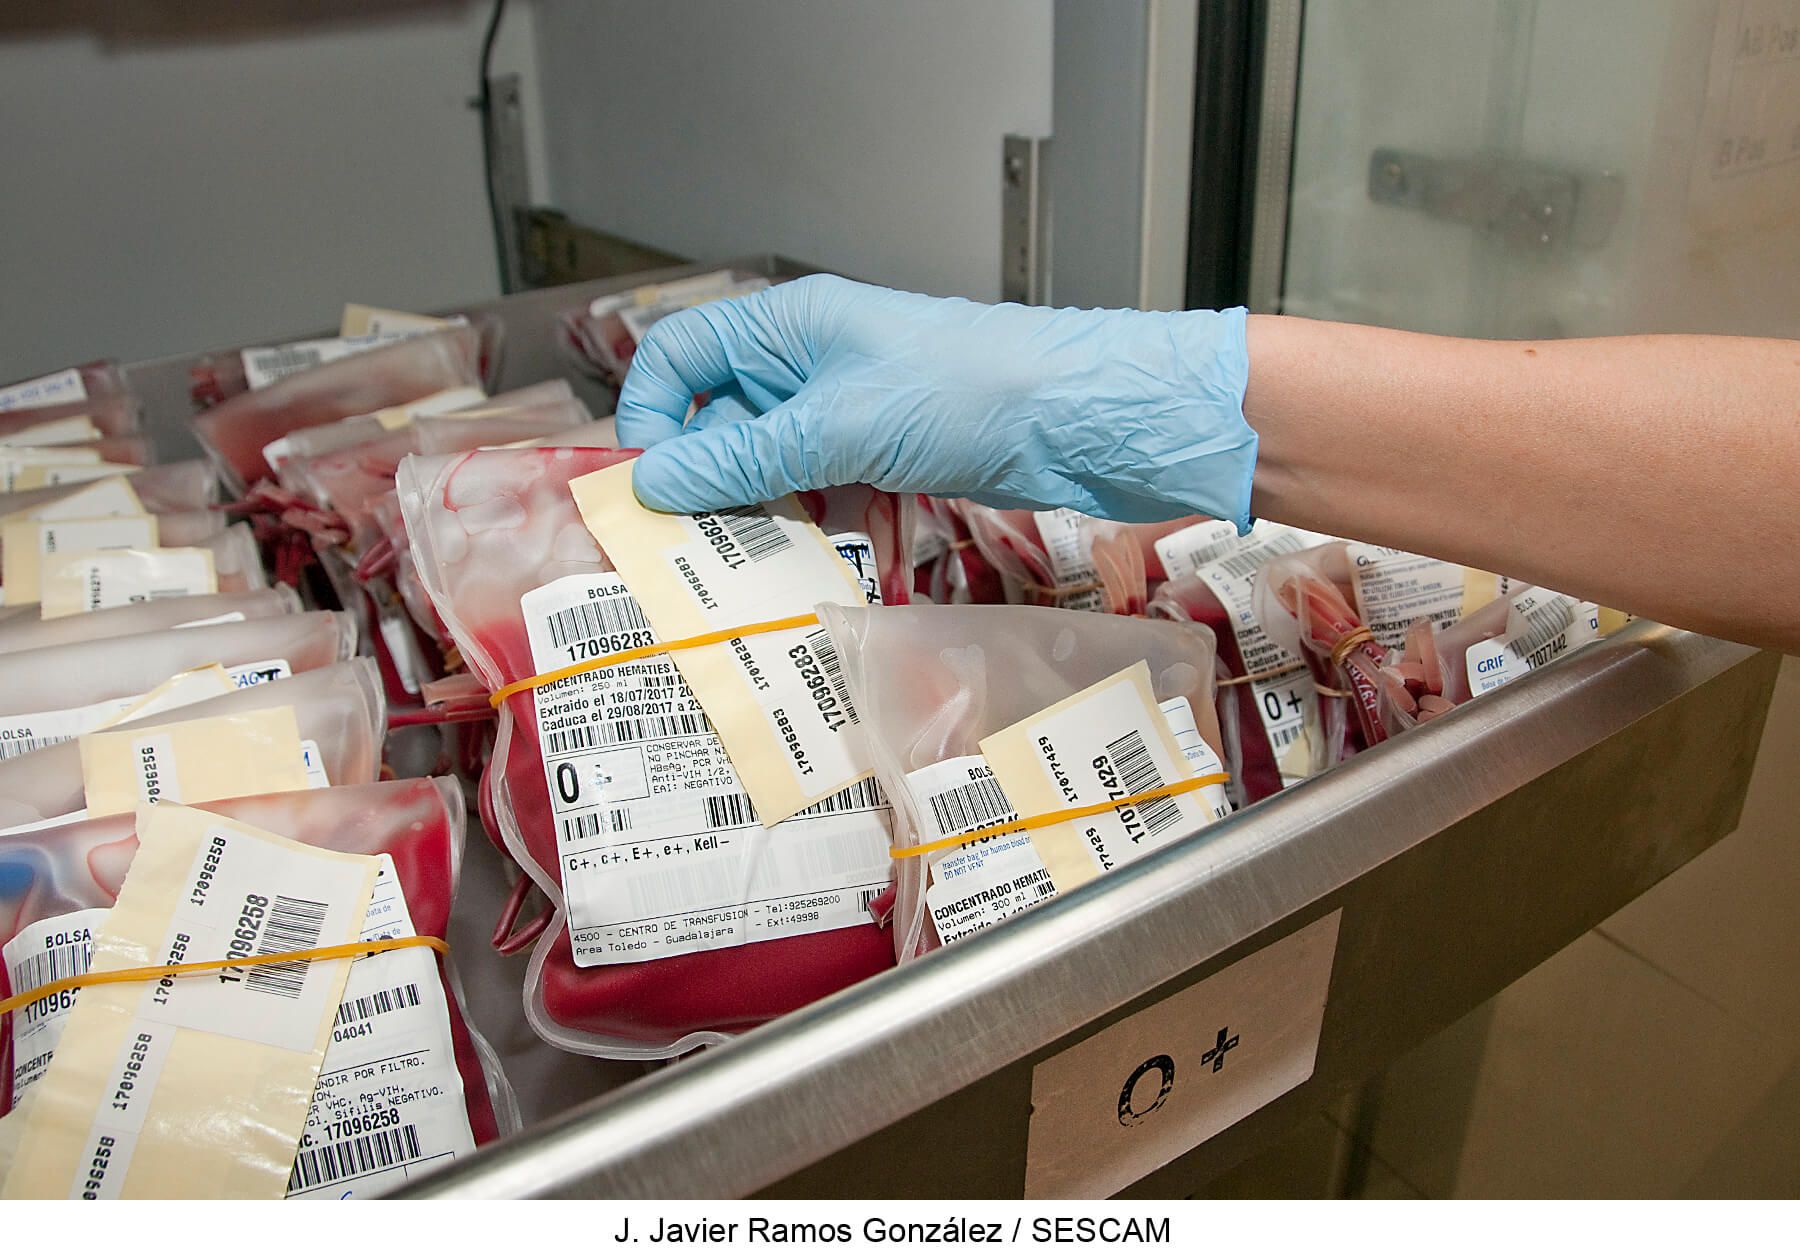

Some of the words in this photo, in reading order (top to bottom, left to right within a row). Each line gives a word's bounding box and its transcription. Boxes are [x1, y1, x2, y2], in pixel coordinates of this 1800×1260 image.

[587, 584, 629, 600] BOLSA
[674, 556, 719, 610] 17096283
[566, 630, 655, 662] 17096283
[536, 668, 615, 696] CONCENTRADO
[617, 662, 671, 678] HEMATIES
[537, 686, 585, 705] Volumen:
[592, 682, 611, 692] 250
[788, 644, 846, 732] 17096283
[540, 696, 590, 719] Extraido
[594, 694, 606, 707] el
[610, 686, 675, 705] 18/07/2017
[542, 713, 587, 732] Caduca
[592, 709, 603, 722] el
[607, 702, 673, 720] 29/08/2017
[677, 702, 685, 711] a
[0, 728, 33, 741] OLSA
[646, 738, 701, 753] CONSERVAR
[707, 737, 720, 746] DE
[772, 708, 814, 775] 17096283
[648, 752, 662, 762] NO
[666, 748, 710, 760] PINCHAR
[693, 758, 711, 768] PCR
[1038, 736, 1079, 803] 17077429
[652, 771, 702, 784] Anti-VIH
[653, 784, 678, 794] EAI:
[684, 777, 733, 790] NEGATIVO
[190, 836, 227, 906] 17096258
[934, 882, 1012, 920] CONCENTRADO
[938, 907, 985, 931] Volumen:
[991, 898, 1011, 911] 300
[1015, 891, 1026, 902] ml
[574, 931, 600, 942] 4500
[618, 923, 658, 938] CENTRO
[664, 920, 677, 931] DE
[683, 908, 749, 928] TRANSFUSION
[766, 895, 841, 914] Tel:925269200
[576, 945, 603, 956] Area
[608, 940, 647, 952] Toledo
[665, 927, 734, 945] Guadalajara
[767, 912, 820, 928] Ext:49998
[45, 928, 92, 949] BOLSA
[333, 1022, 373, 1043] 04041
[1201, 1026, 1240, 1073] +
[112, 1033, 153, 1111] 17096258
[354, 1067, 375, 1080] POR
[380, 1056, 425, 1074] FILTRO.
[335, 1102, 383, 1120] Sifilis
[388, 1086, 444, 1106] NEGATIVO.
[323, 1108, 400, 1141] 17096258
